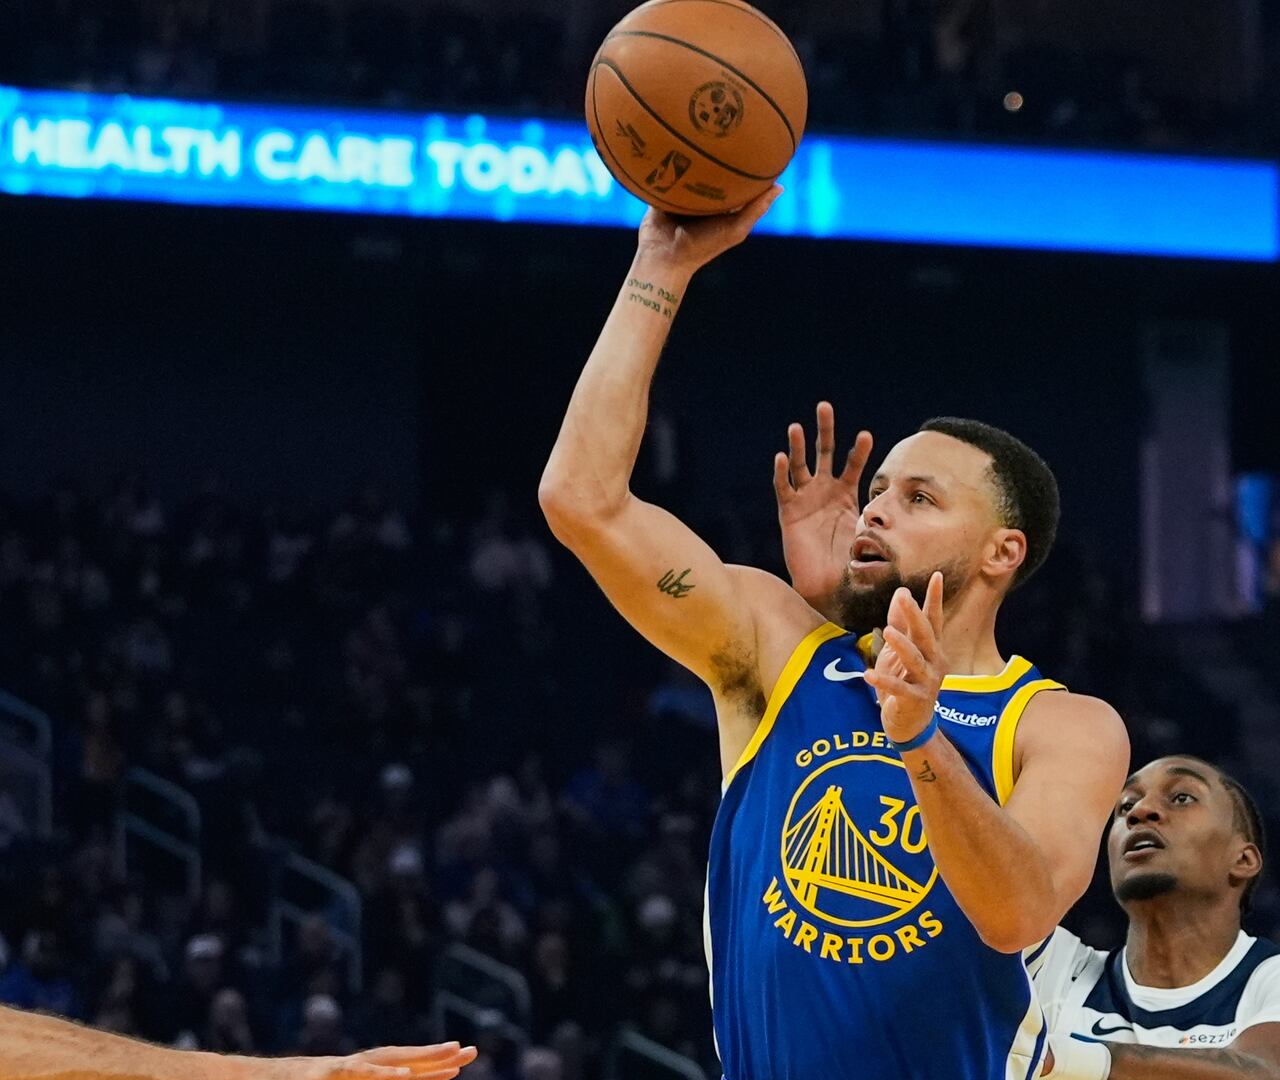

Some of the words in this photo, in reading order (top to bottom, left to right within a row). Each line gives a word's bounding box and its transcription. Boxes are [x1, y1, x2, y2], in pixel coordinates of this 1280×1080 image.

[13, 116, 241, 179] HEALTH
[254, 133, 414, 188] CARE
[427, 140, 613, 197] TODAY
[796, 731, 894, 768] GOLDE
[869, 795, 929, 854] 30
[762, 876, 944, 964] WARRIORS
[1189, 1028, 1238, 1044] sezzle
